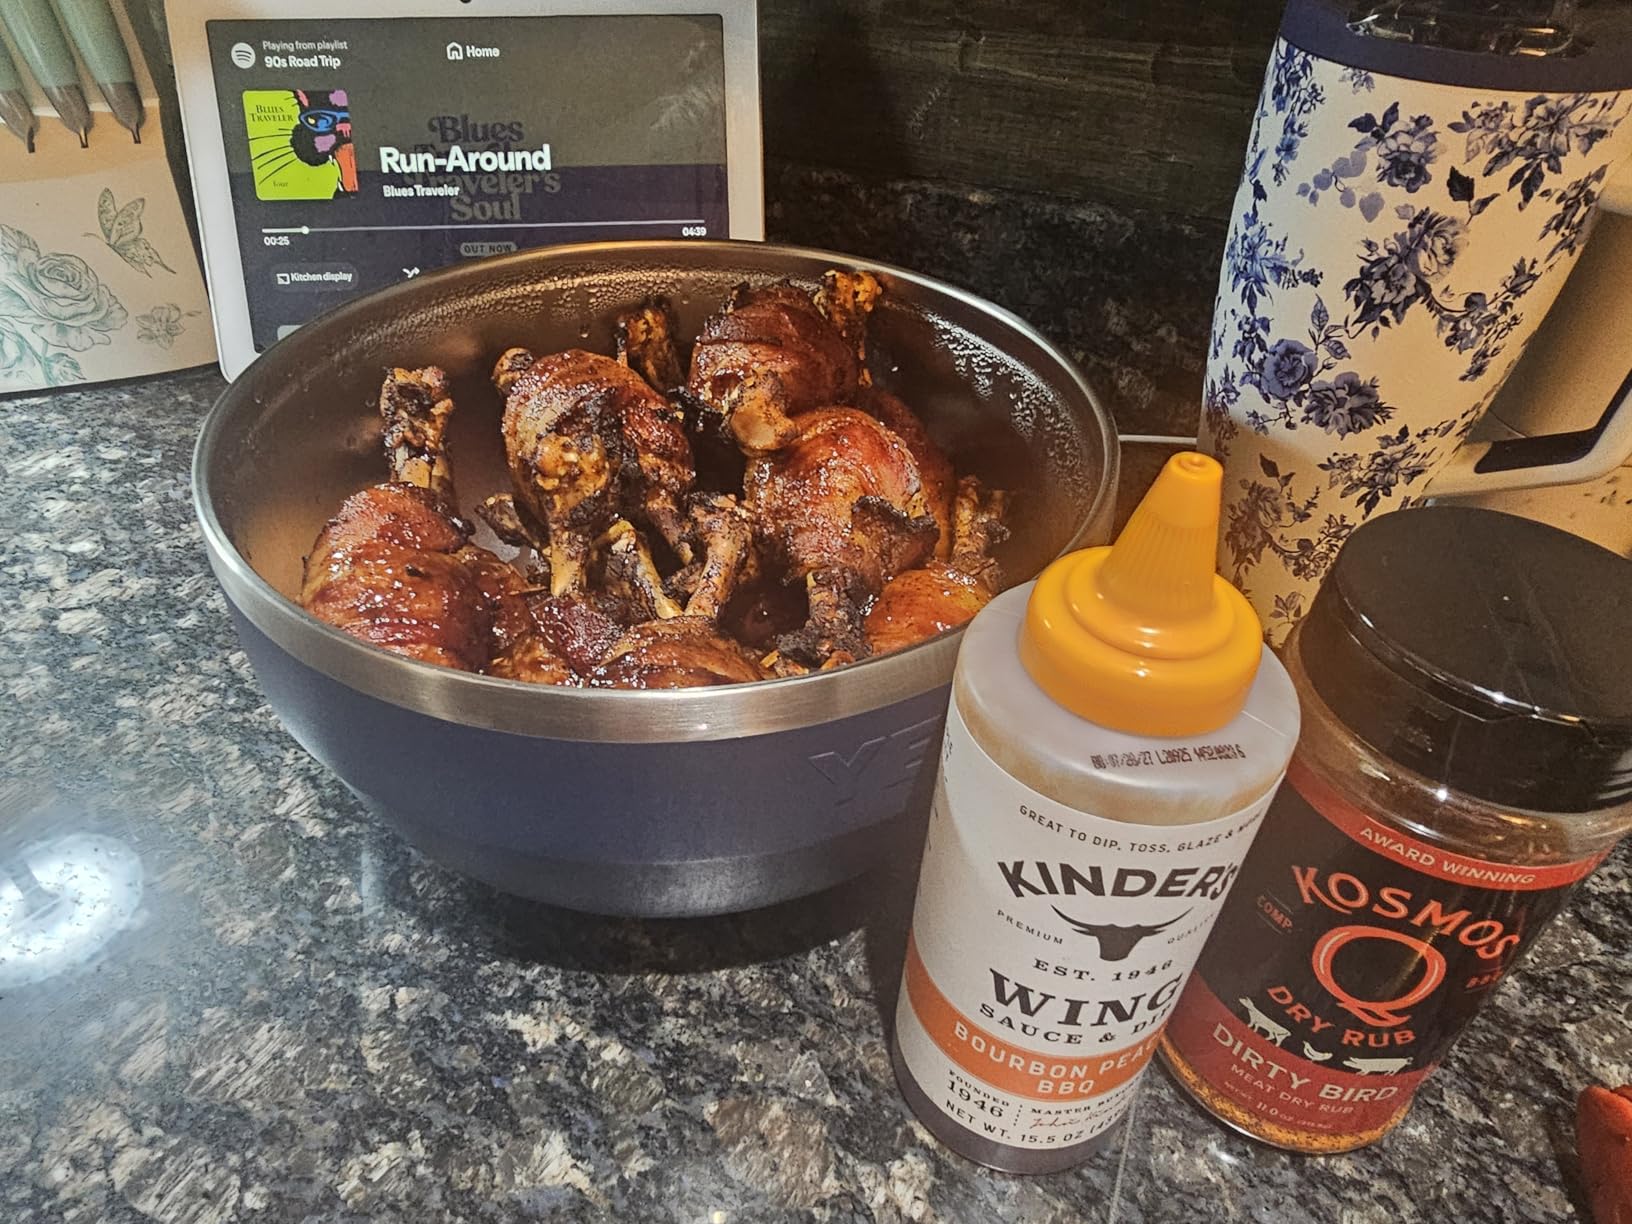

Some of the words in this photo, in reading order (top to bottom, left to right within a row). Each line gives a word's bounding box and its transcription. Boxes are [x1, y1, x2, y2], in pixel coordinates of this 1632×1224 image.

[262, 40, 294, 52] Playing
[295, 41, 316, 50] from
[317, 40, 348, 51] playlist
[264, 56, 287, 68] 90s
[288, 56, 318, 68] Road
[319, 55, 341, 69] Trip
[466, 45, 500, 58] Home
[428, 114, 524, 144] Blues
[379, 144, 552, 174] Run-Around
[383, 185, 414, 197] Blues
[414, 184, 460, 197] Traveler
[450, 193, 522, 222] Soul
[264, 236, 290, 246] 00:25
[464, 244, 486, 253] OUT
[489, 244, 513, 253] NOW
[291, 272, 322, 282] Kitchen
[323, 271, 353, 283] display
[1020, 805, 1064, 834] GREAT
[1069, 829, 1087, 842] TO
[1177, 833, 1222, 851] GLAZE
[1360, 827, 1436, 867] AWARD
[1442, 860, 1536, 885] WINNING
[997, 860, 1239, 901] KINDER'S
[997, 909, 1063, 945] PREMIUM
[1291, 865, 1521, 960] KOSMOS
[1033, 958, 1095, 981] EST.
[1112, 960, 1174, 982] 1946
[1311, 925, 1447, 1028] Q
[989, 967, 1184, 1027] WING
[980, 1003, 1083, 1044] SAUCE
[1098, 1032, 1116, 1043] &
[1267, 985, 1335, 1033] DRY
[1341, 1028, 1417, 1049] RUB
[953, 1021, 1088, 1080] BOURBON
[1213, 1023, 1311, 1090] DIRTY
[1318, 1083, 1399, 1103] BIRD
[947, 1079, 1004, 1118] 1946
[949, 1069, 1010, 1107] FOUNDED
[1037, 1079, 1095, 1095] BBQ
[1231, 1064, 1276, 1093] MEAT
[1279, 1091, 1315, 1109] DRY
[1319, 1103, 1354, 1115] RUB
[946, 1099, 976, 1124] NET
[983, 1121, 1011, 1140] WT.
[1020, 1133, 1057, 1144] 15.5
[1031, 1105, 1092, 1116] MASTER
